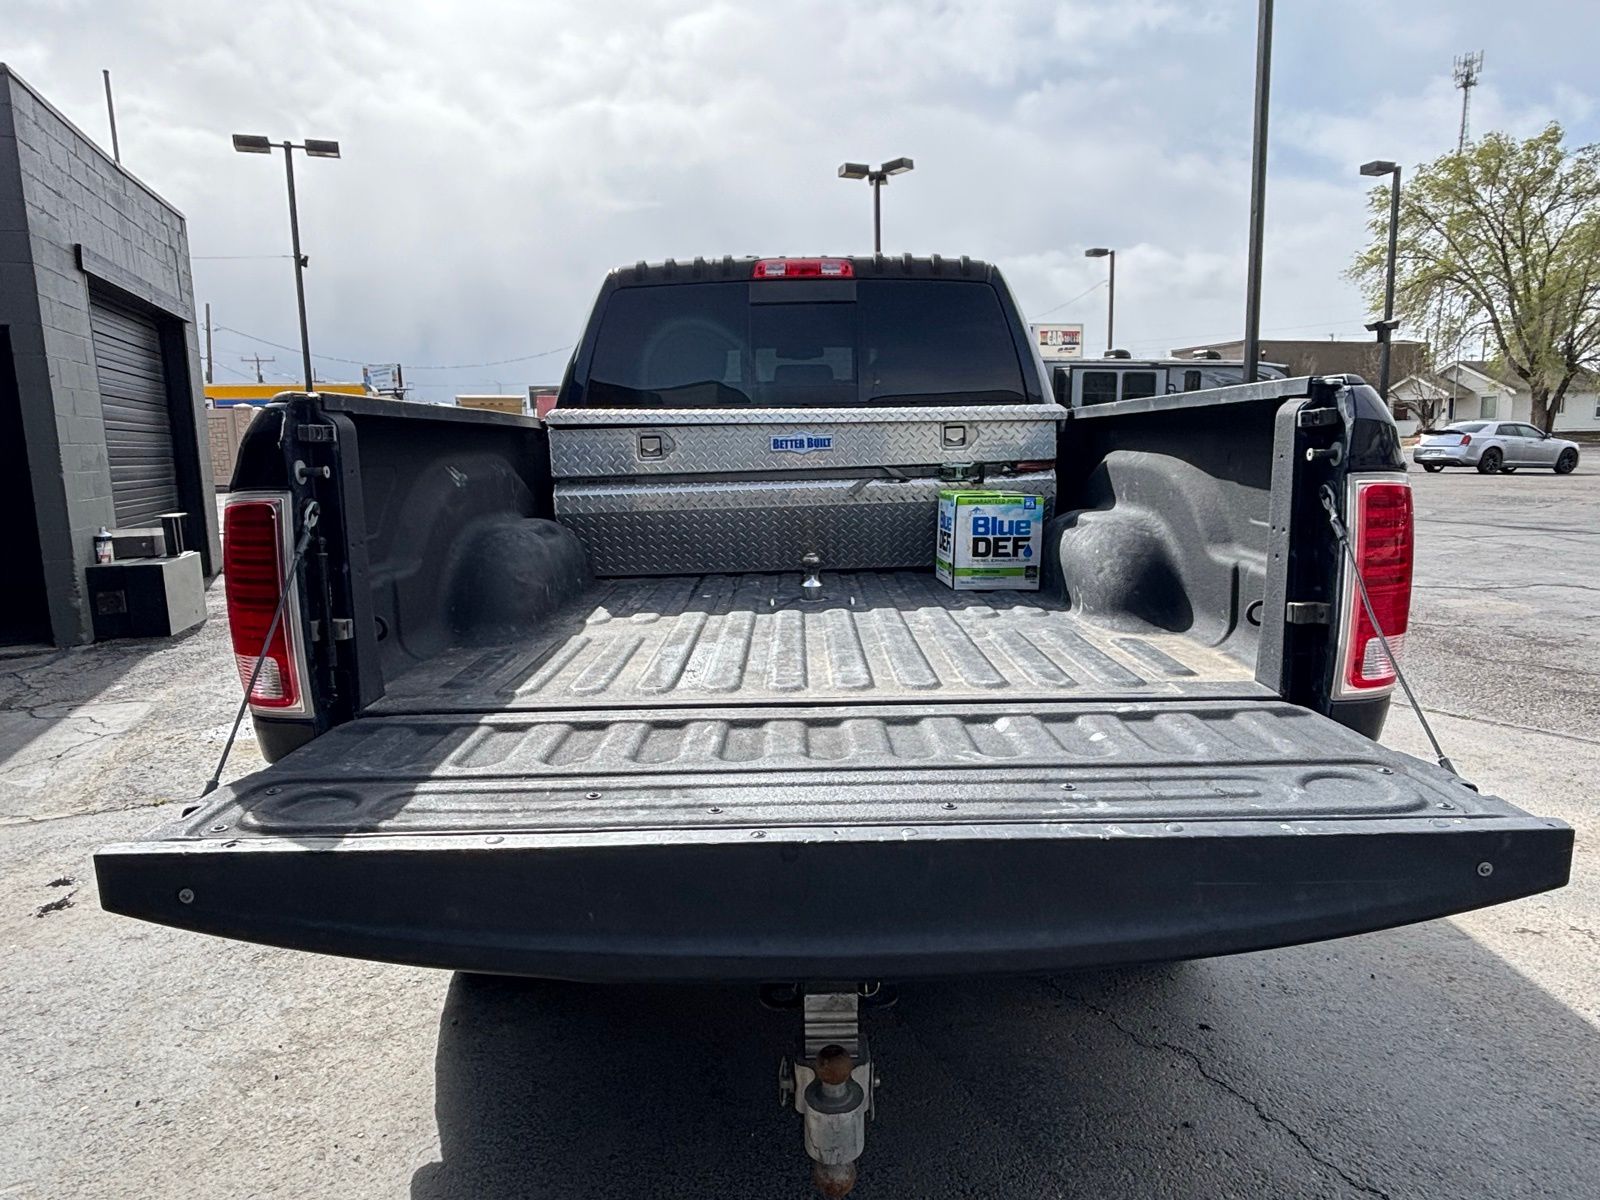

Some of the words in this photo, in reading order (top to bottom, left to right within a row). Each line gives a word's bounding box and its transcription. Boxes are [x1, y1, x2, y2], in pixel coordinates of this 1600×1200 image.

[773, 439, 805, 449] BETTER
[807, 437, 832, 448] BUILT
[972, 517, 1031, 536] Blue
[972, 537, 1031, 558] DEF
